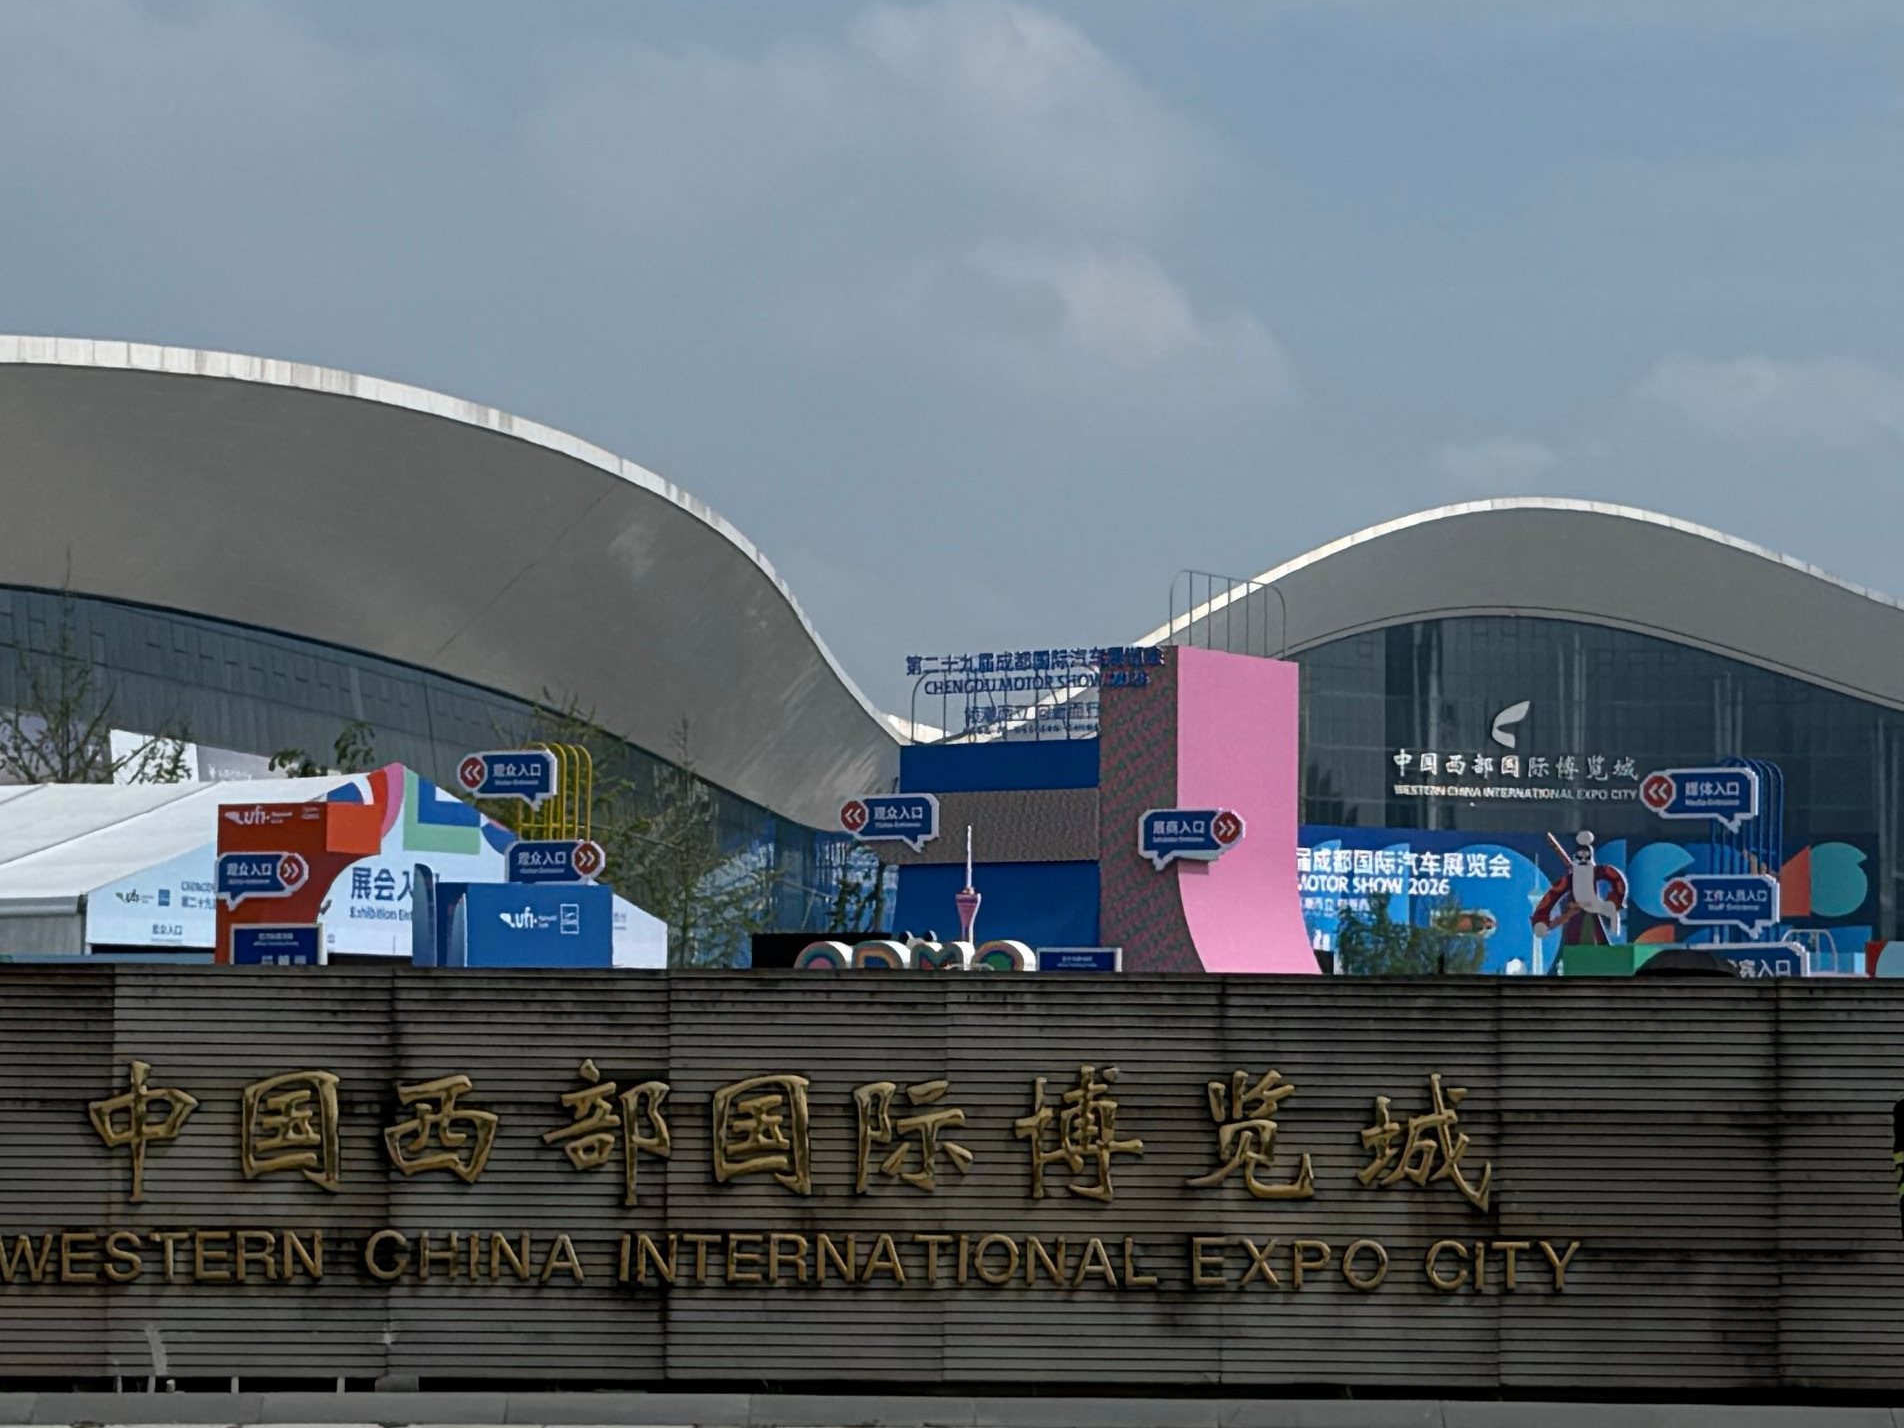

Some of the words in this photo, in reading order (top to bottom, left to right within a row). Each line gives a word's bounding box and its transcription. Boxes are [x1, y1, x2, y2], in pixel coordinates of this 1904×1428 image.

[924, 677, 995, 695] CHENGDU
[999, 673, 1053, 692] MOTOR
[493, 763, 541, 777] 观众入口
[1393, 748, 1640, 780] 中国西部国际博览城
[1394, 784, 1446, 797] WESTERN
[1447, 785, 1483, 798] CHINA
[1483, 786, 1574, 800] INTERNATIONAL
[1576, 788, 1608, 800] EXPO
[1610, 788, 1638, 801] CITY
[1685, 781, 1740, 796] 媒体入口
[874, 805, 923, 820] 观众入口
[351, 867, 439, 901] 展会入
[1353, 876, 1403, 894] SHOW
[1408, 878, 1450, 895] 2026
[89, 1058, 1492, 1212] 中国西部国际博览城
[364, 1228, 585, 1282] CHINA
[619, 1232, 1157, 1287] INTERNATIONAL
[1191, 1235, 1389, 1289] EXPO
[1425, 1239, 1581, 1292] CITY
